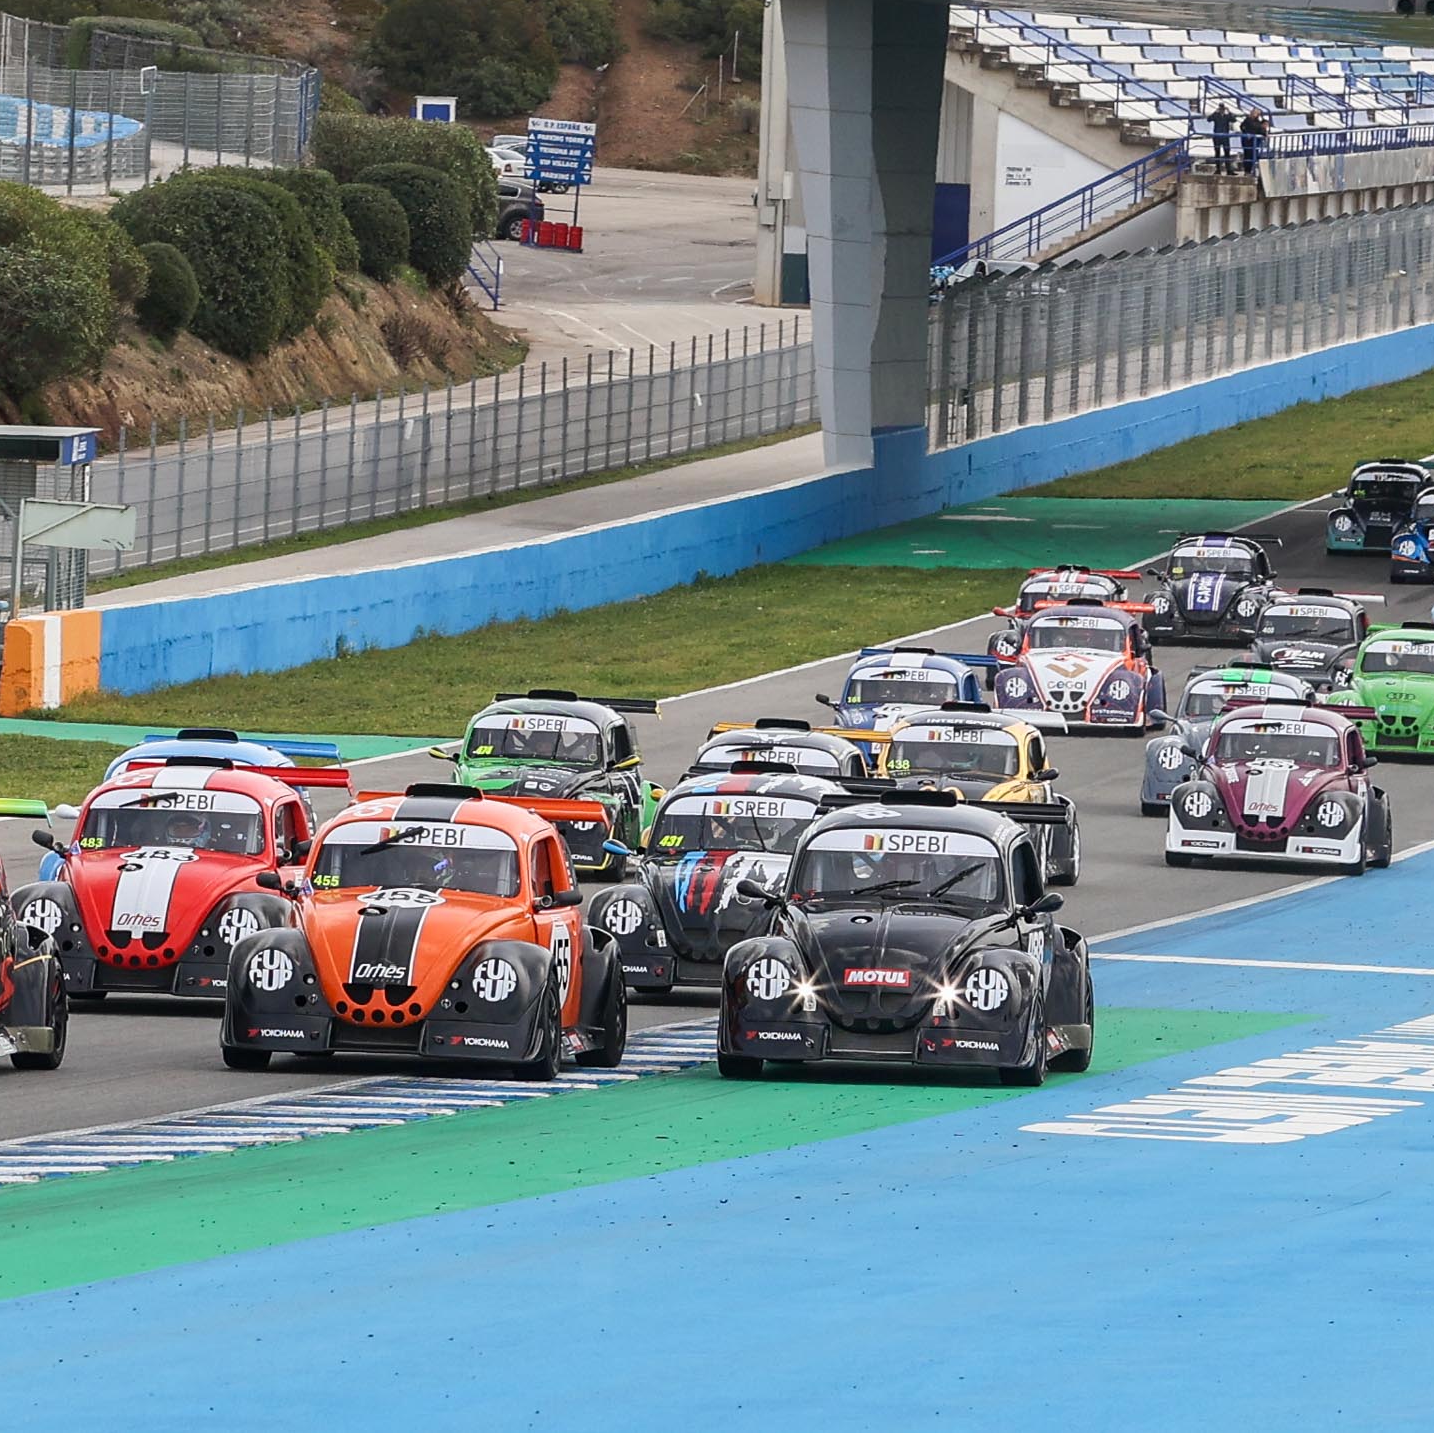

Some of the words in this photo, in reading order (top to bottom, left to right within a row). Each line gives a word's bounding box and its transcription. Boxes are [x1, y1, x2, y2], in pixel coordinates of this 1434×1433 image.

[887, 759, 910, 770] 438
[80, 837, 103, 848] 483
[659, 835, 684, 847] 431
[124, 851, 194, 863] 483
[314, 875, 340, 887] 455
[366, 890, 437, 904] 455
[24, 898, 62, 917] FUN
[606, 899, 642, 917] FUN
[221, 908, 258, 928] FUN
[606, 916, 642, 935] CUP
[250, 949, 293, 970] FUN
[748, 958, 790, 979] FUN
[474, 959, 516, 980] FUN
[847, 970, 908, 984] MOTUL
[968, 968, 1008, 989] FUN
[249, 969, 293, 991] CUP
[746, 978, 790, 1000] CUP
[472, 979, 517, 1002] CUP
[965, 987, 1008, 1011] CUP
[260, 1028, 305, 1039] YOKOHAMA
[758, 1031, 802, 1041] YOKOHAMA
[463, 1037, 510, 1049] YOKOHAMA
[954, 1039, 1000, 1052] YOKOHAMA
